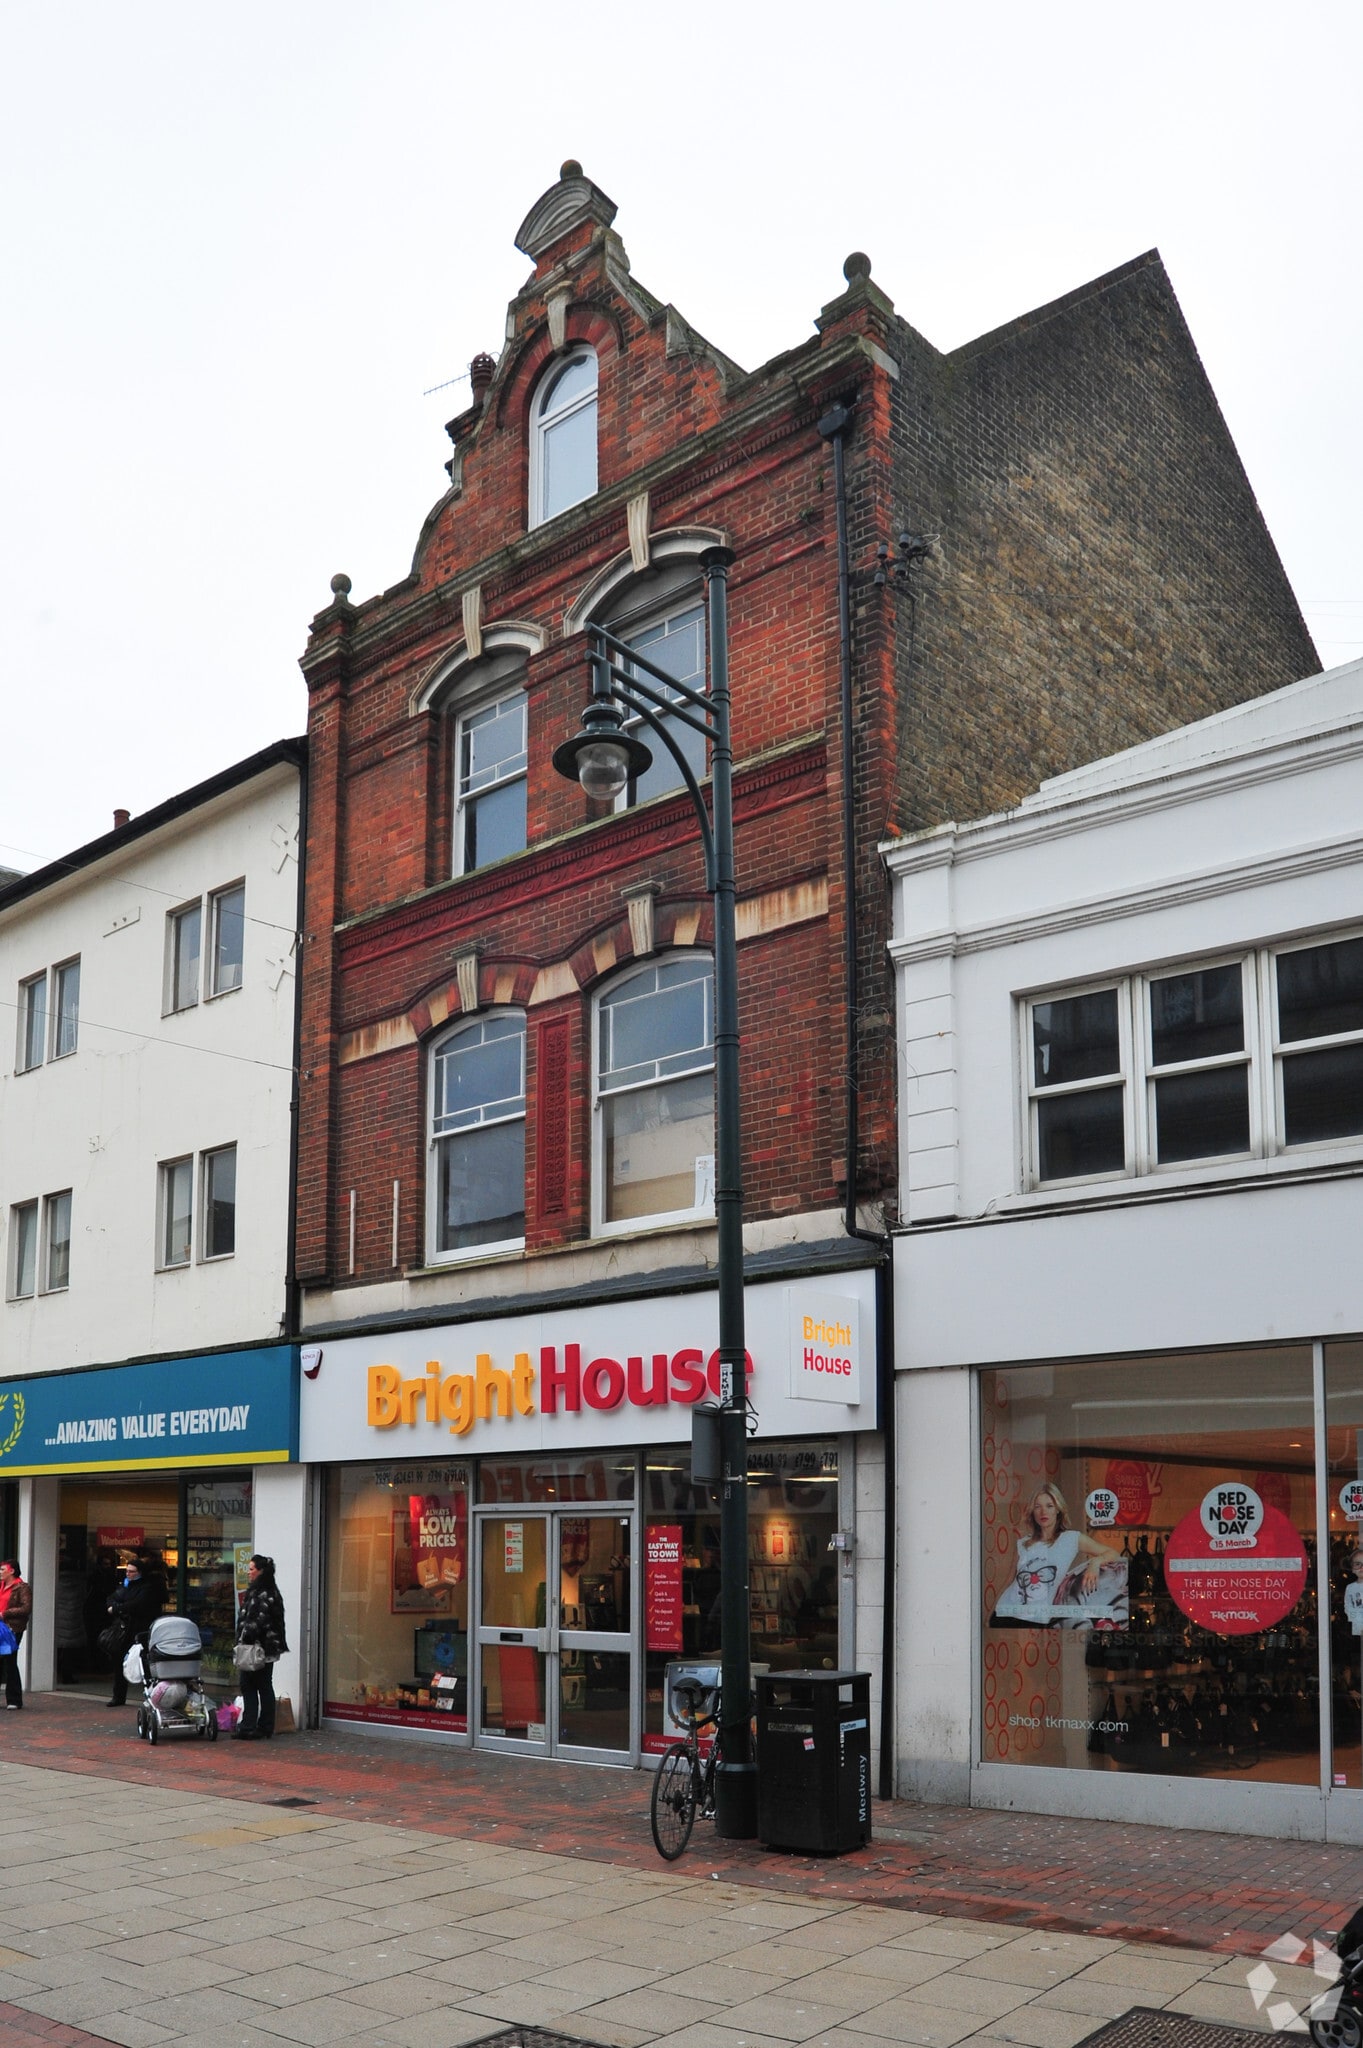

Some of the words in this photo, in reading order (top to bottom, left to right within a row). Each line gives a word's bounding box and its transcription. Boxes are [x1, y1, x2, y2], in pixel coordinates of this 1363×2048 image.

[803, 1315, 851, 1348] Bright
[803, 1347, 852, 1376] House
[121, 1413, 166, 1440] VALUE
[170, 1405, 250, 1436] EVERYDAY
[1094, 1493, 1110, 1501] RED
[1351, 1486, 1363, 1495] RE
[1218, 1492, 1246, 1505] RED
[1090, 1501, 1114, 1510] NOSE
[1094, 1510, 1111, 1518] DAY
[1209, 1506, 1255, 1521] NOSE
[419, 1515, 457, 1534] LOW
[1218, 1521, 1248, 1535] DAY
[419, 1533, 457, 1548] PRICES
[1225, 1539, 1251, 1548] March
[648, 1550, 659, 1558] TO
[659, 1550, 679, 1558] OWN
[1184, 1578, 1202, 1588] THE
[1206, 1578, 1226, 1588] RED
[1230, 1578, 1261, 1588] NOSE
[1265, 1578, 1287, 1588] DAY
[1180, 1590, 1217, 1600] T-SHIRT
[1221, 1590, 1290, 1600] COLLECTION
[1009, 1714, 1041, 1729] shop
[1045, 1715, 1129, 1732] tkmaxx.com
[859, 1754, 868, 1822] Medway
